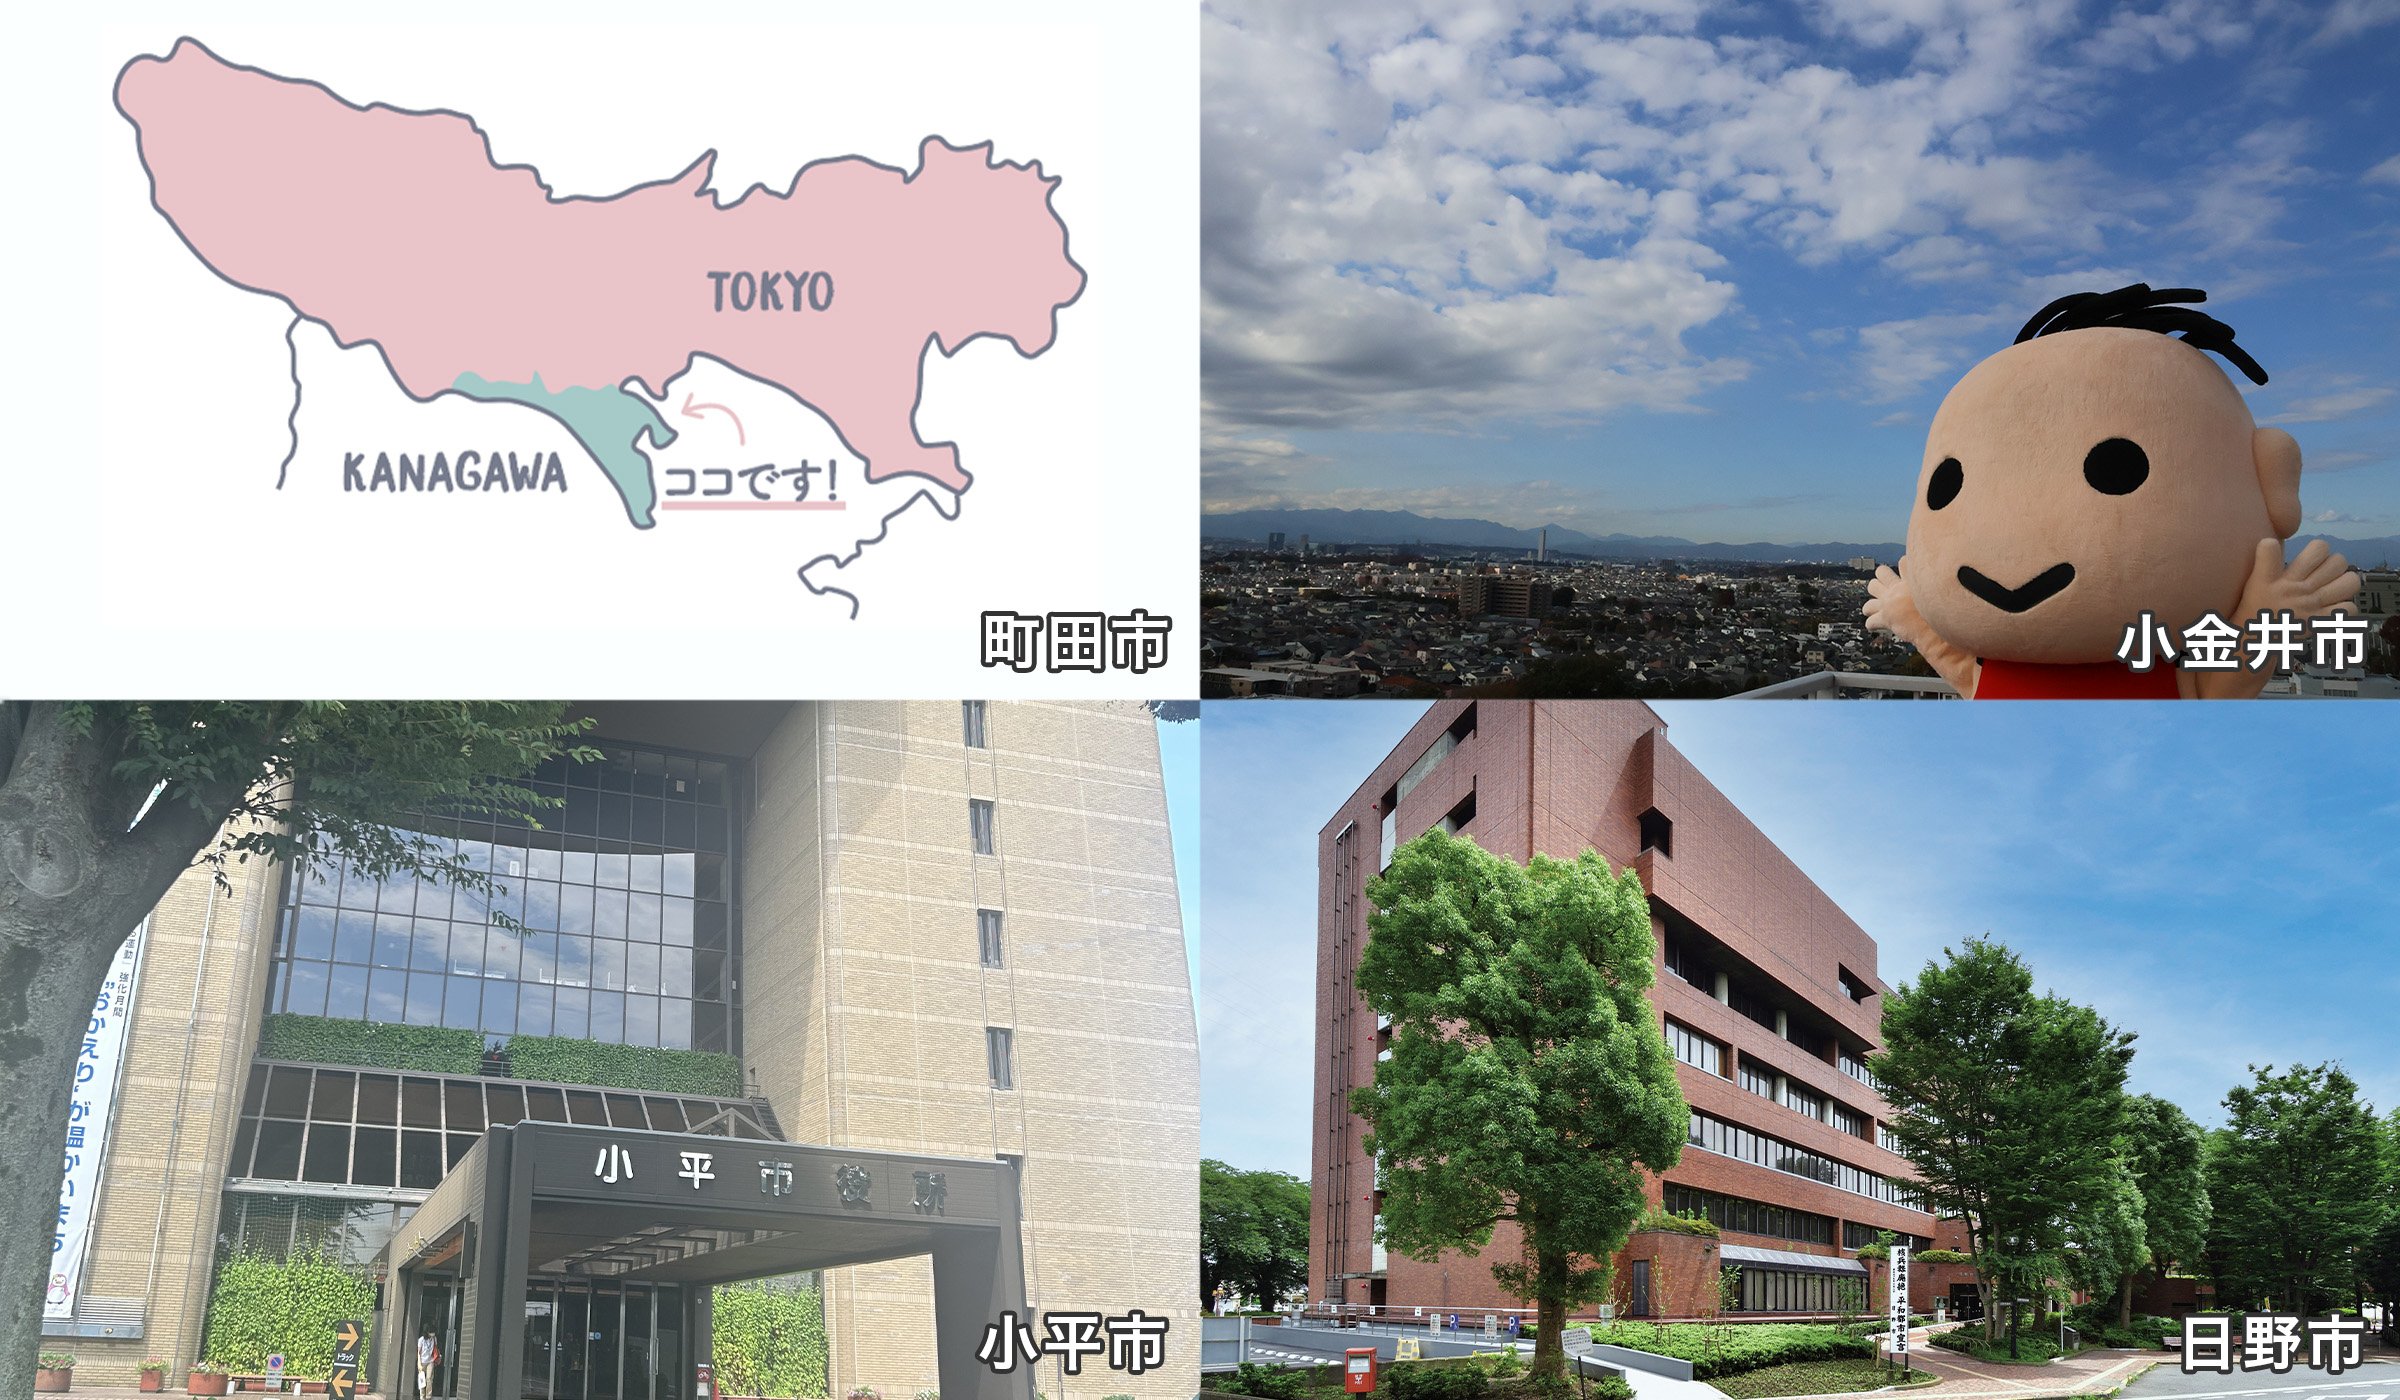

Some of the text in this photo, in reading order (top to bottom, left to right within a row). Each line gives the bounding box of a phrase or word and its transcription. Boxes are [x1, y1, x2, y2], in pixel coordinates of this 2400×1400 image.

[708, 271, 834, 312] TOKYO
[345, 451, 566, 492] KANAGAWA
[667, 460, 838, 502] ココです!
[595, 1144, 947, 1208] 小平市役所
[1450, 1315, 1455, 1327] P
[1509, 1317, 1515, 1330] P
[337, 1353, 354, 1361] トラック
